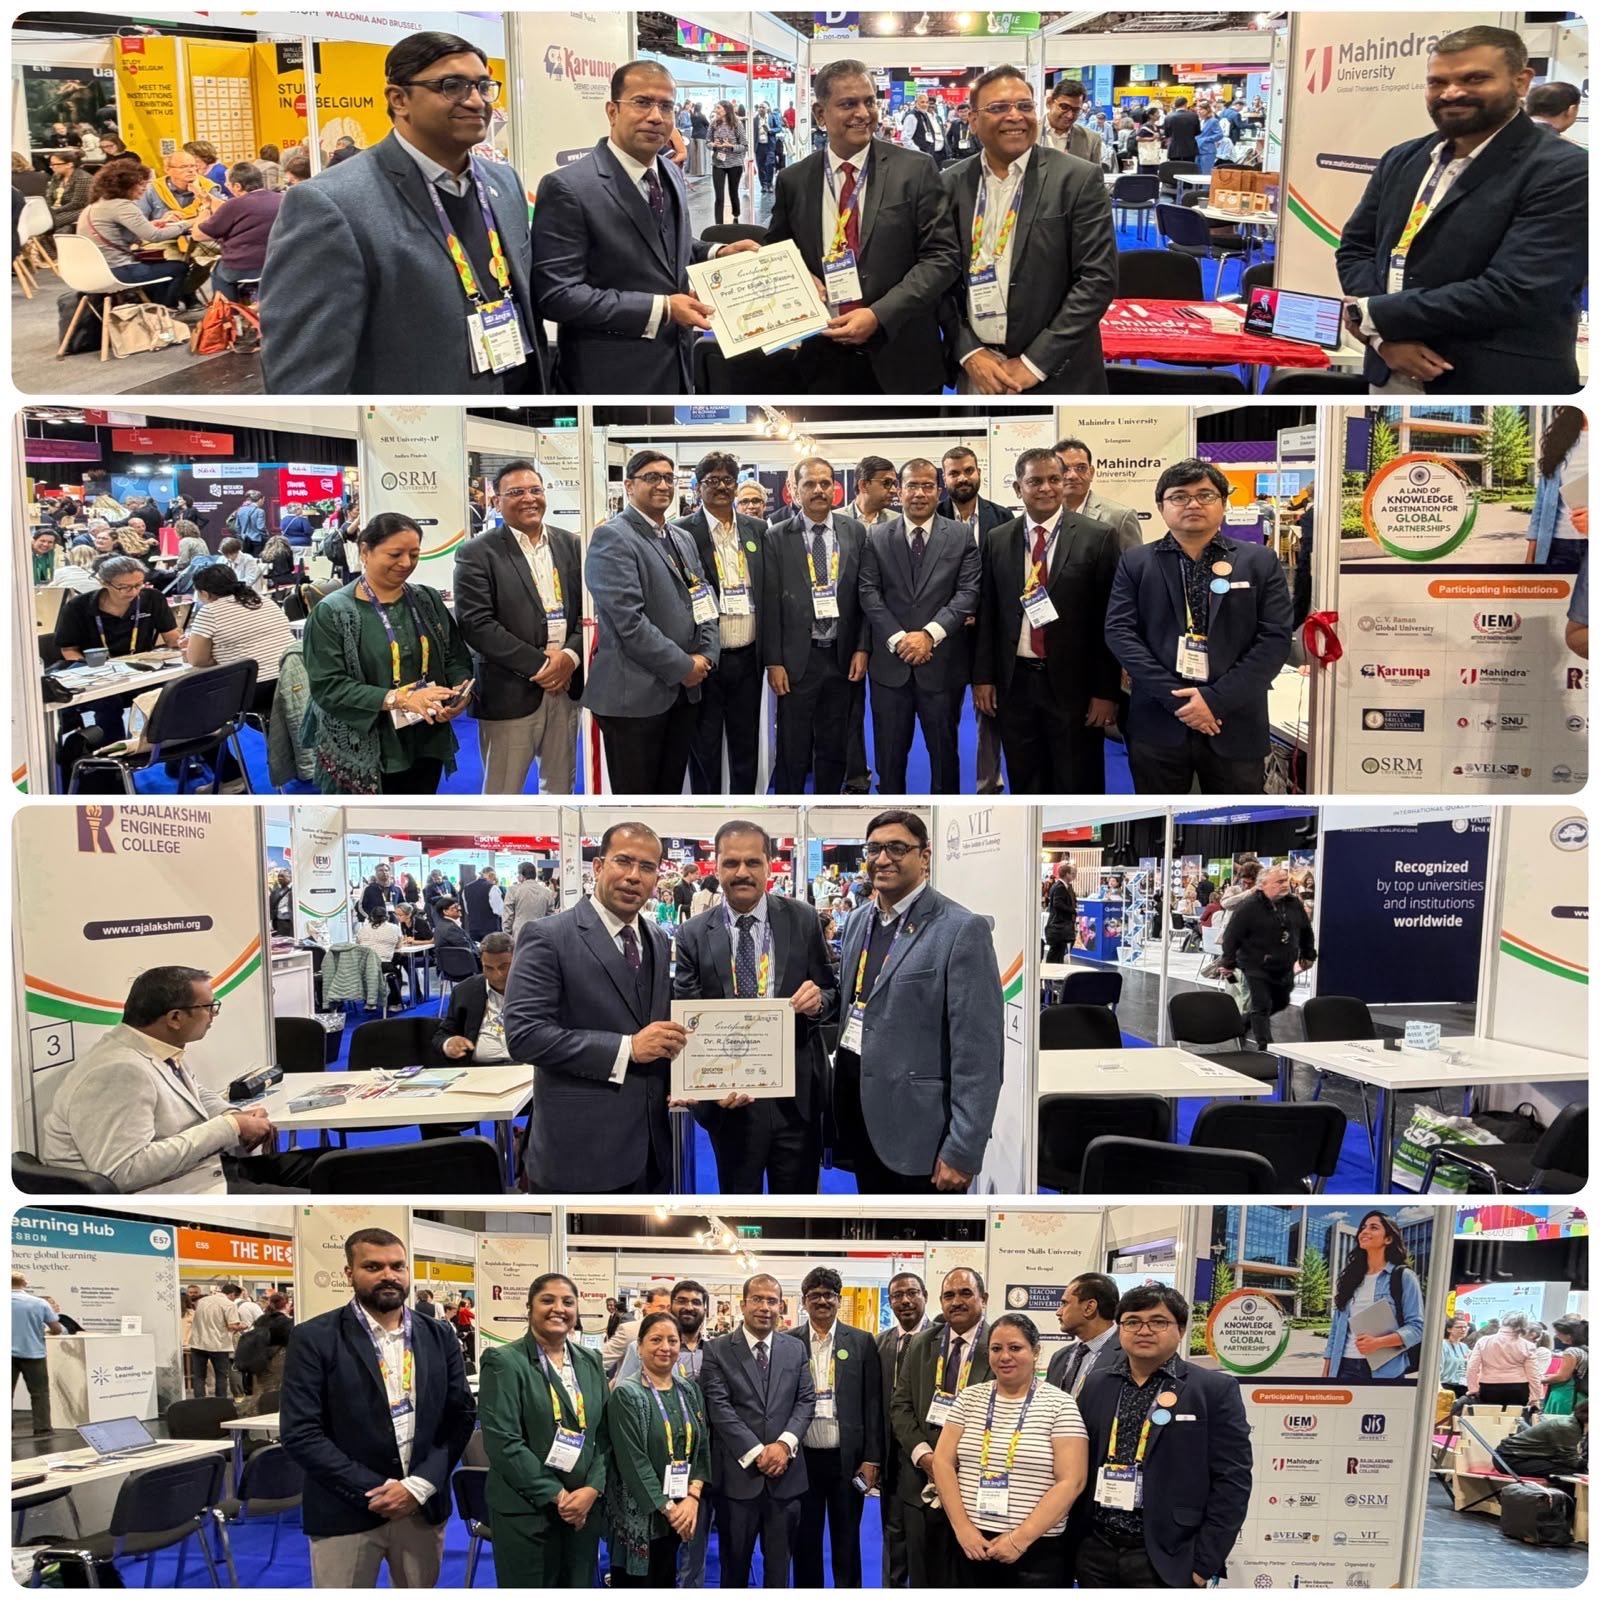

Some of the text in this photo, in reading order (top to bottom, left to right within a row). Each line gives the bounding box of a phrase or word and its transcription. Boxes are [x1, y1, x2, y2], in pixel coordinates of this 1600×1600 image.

[325, 11, 370, 26] WALLONIA
[371, 16, 389, 27] AND
[389, 18, 424, 32] BRUSSELS
[1339, 32, 1439, 65] Mahindra
[1337, 66, 1396, 82] University
[1381, 83, 1410, 93] Engaged
[279, 97, 374, 109] IN BELGIUM
[1115, 325, 1190, 336] University
[1078, 417, 1158, 428] Mahindra University
[397, 435, 440, 444] University-AP
[1096, 457, 1162, 469] Mahindra
[398, 471, 437, 486] SRM
[1096, 470, 1137, 479] University
[1387, 495, 1454, 504] KNOWLEDGE
[1389, 505, 1441, 513] DESTINATION
[1395, 514, 1443, 523] GLOBAL
[1387, 524, 1452, 532] PARTNERSHIPS
[1438, 584, 1559, 596] Participating Institutions
[1482, 614, 1513, 627] IEM
[1398, 624, 1434, 634] University
[1376, 664, 1430, 680] Karunya
[1479, 667, 1526, 677] Mahindra
[1501, 716, 1524, 726] SNU
[1381, 759, 1423, 770] SRM
[1473, 763, 1508, 773] VELS
[119, 805, 212, 825] RAJALAKSHMI
[1393, 807, 1445, 816] INTERNATIONAL
[968, 809, 992, 836] VIT
[1470, 823, 1485, 833] Test
[76, 805, 117, 854] R
[121, 819, 205, 840] ENGINEERING
[122, 837, 181, 854] COLLEGE
[316, 855, 328, 865] IEM
[1394, 860, 1469, 877] Recognized
[1376, 879, 1484, 895] by top universities
[1383, 897, 1475, 910] and institutions
[1393, 914, 1463, 928] worldwide
[103, 919, 201, 936] www.rajalakshmi.org
[1012, 1015, 1018, 1032] 4
[46, 1034, 62, 1056] 3
[82, 1220, 116, 1237] Hub
[152, 1234, 169, 1245] E57
[230, 1240, 259, 1260] THE
[1027, 1247, 1046, 1256] Skills
[1047, 1248, 1083, 1258] University
[37, 1250, 98, 1264] global learning
[32, 1262, 72, 1273] together.
[493, 1285, 502, 1300] R
[579, 1291, 607, 1300] Karunya
[1224, 1321, 1273, 1330] KNOWLEDGE
[1230, 1336, 1265, 1344] GLOBAL
[1224, 1344, 1271, 1352] PARTNERSHIPS
[1259, 1393, 1345, 1403] Participating Institutions
[1289, 1416, 1312, 1427] IEM
[1286, 1458, 1320, 1466] Mahindra
[1300, 1495, 1316, 1503] SNU
[1358, 1495, 1389, 1506] SRM
[1360, 1531, 1377, 1540] VIT
[1291, 1561, 1317, 1569] Community
